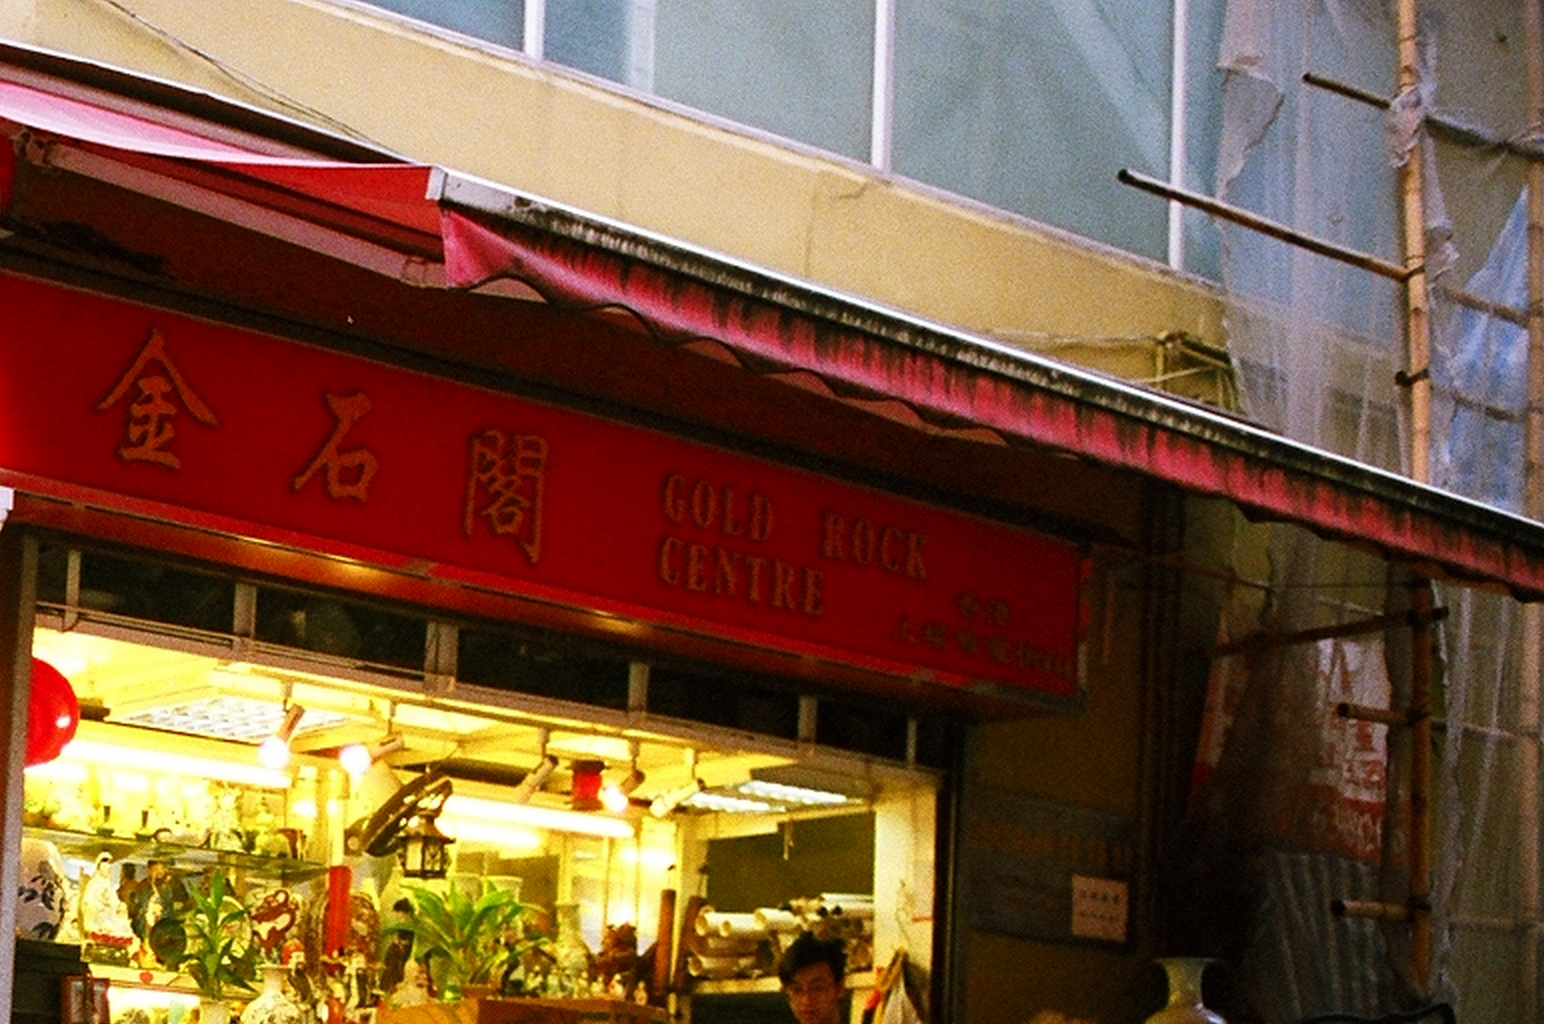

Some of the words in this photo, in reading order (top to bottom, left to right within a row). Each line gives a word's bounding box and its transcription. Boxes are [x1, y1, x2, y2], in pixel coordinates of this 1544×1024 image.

[663, 474, 774, 541] GOLD
[820, 509, 928, 580] ROCK
[660, 536, 823, 616] CENTRE
